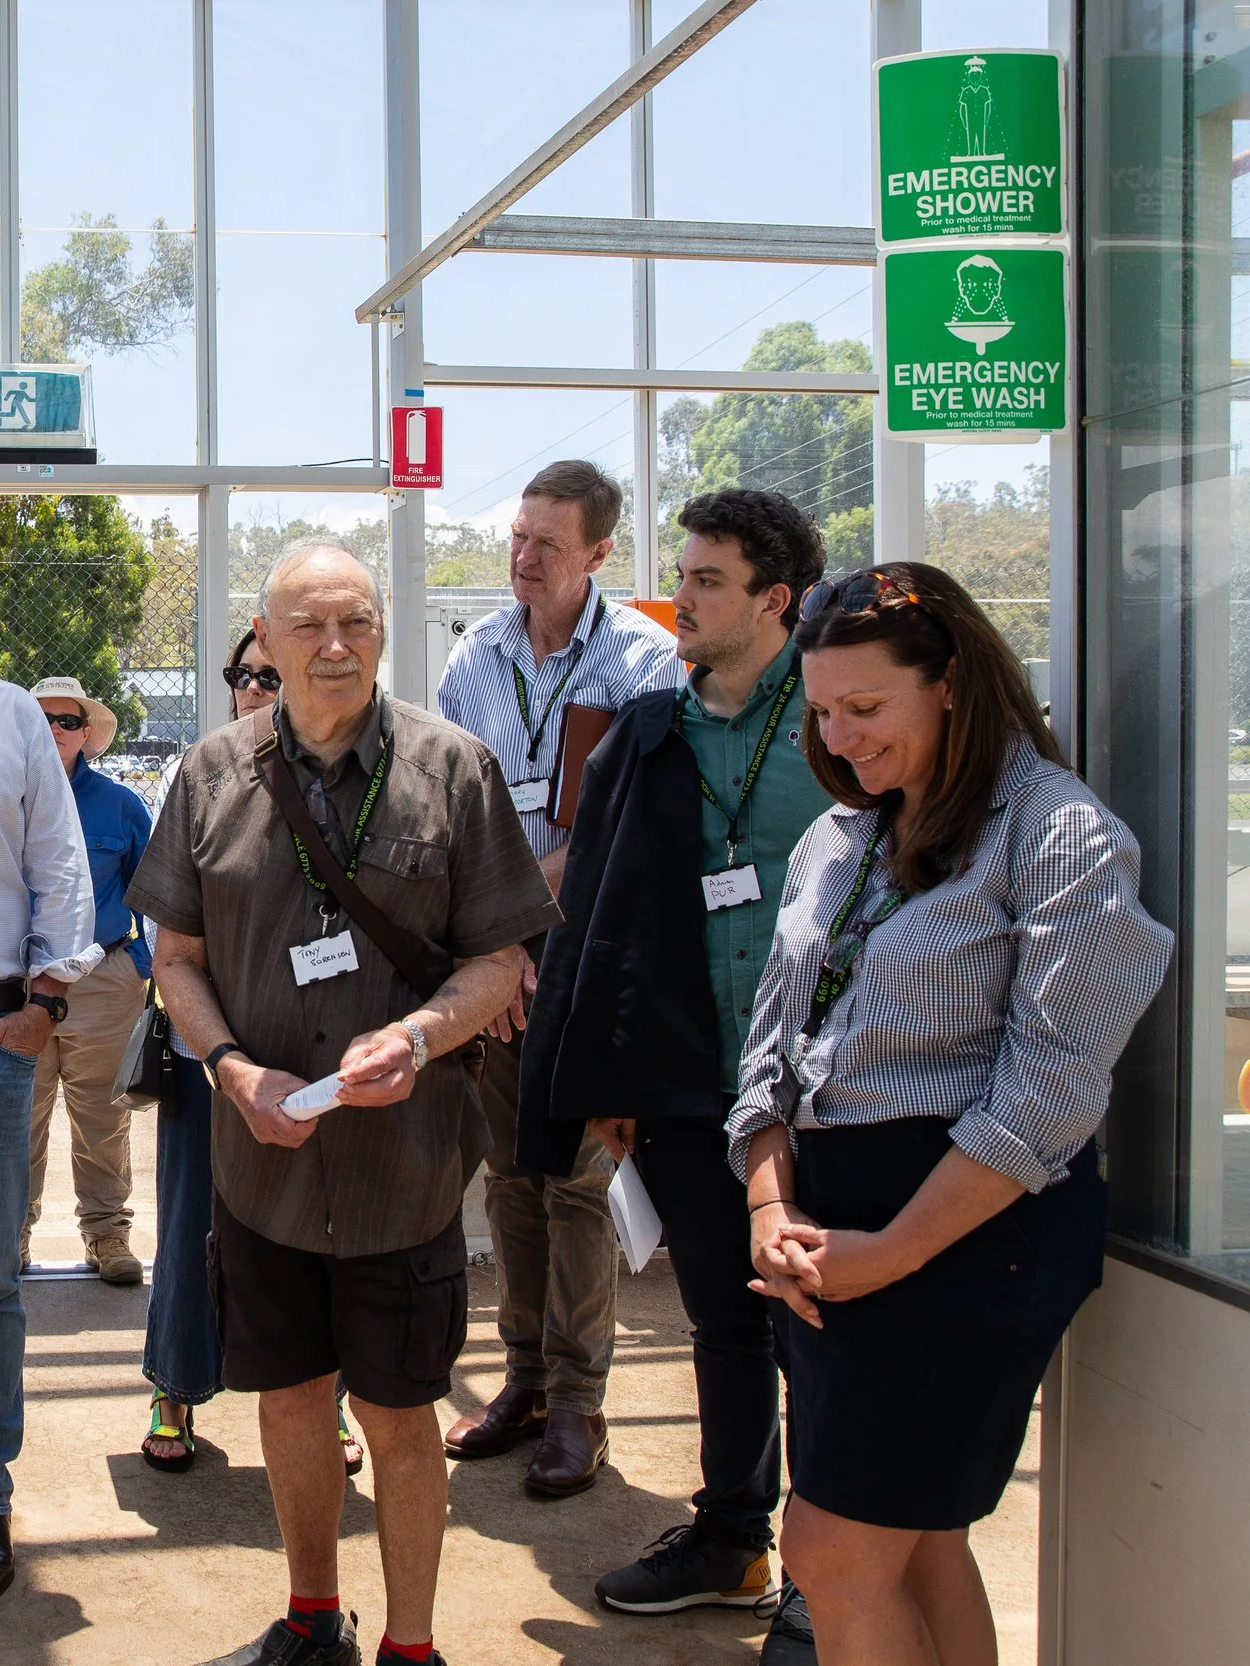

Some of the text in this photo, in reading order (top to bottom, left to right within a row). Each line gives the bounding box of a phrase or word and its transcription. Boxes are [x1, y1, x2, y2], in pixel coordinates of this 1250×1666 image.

[888, 165, 1056, 196] EMERGENCY
[916, 191, 1035, 219] SHOWER
[921, 214, 1031, 227] Prior to medical treatment
[942, 226, 966, 234] wash
[982, 223, 992, 231] 15
[894, 361, 1061, 386] EMERGENCY
[911, 387, 1046, 411] EYE WASH
[926, 411, 947, 419] Prior
[946, 420, 969, 428] wash
[985, 419, 995, 427] 15
[996, 419, 1016, 427] mins
[779, 695, 788, 704] 24
[770, 703, 783, 728] HOUR
[750, 727, 773, 773] ASSISTANCE
[357, 779, 382, 827] ASSISTANCE
[299, 852, 311, 874] 6773
[854, 864, 869, 894] HOUR
[817, 976, 832, 1003] 2099
